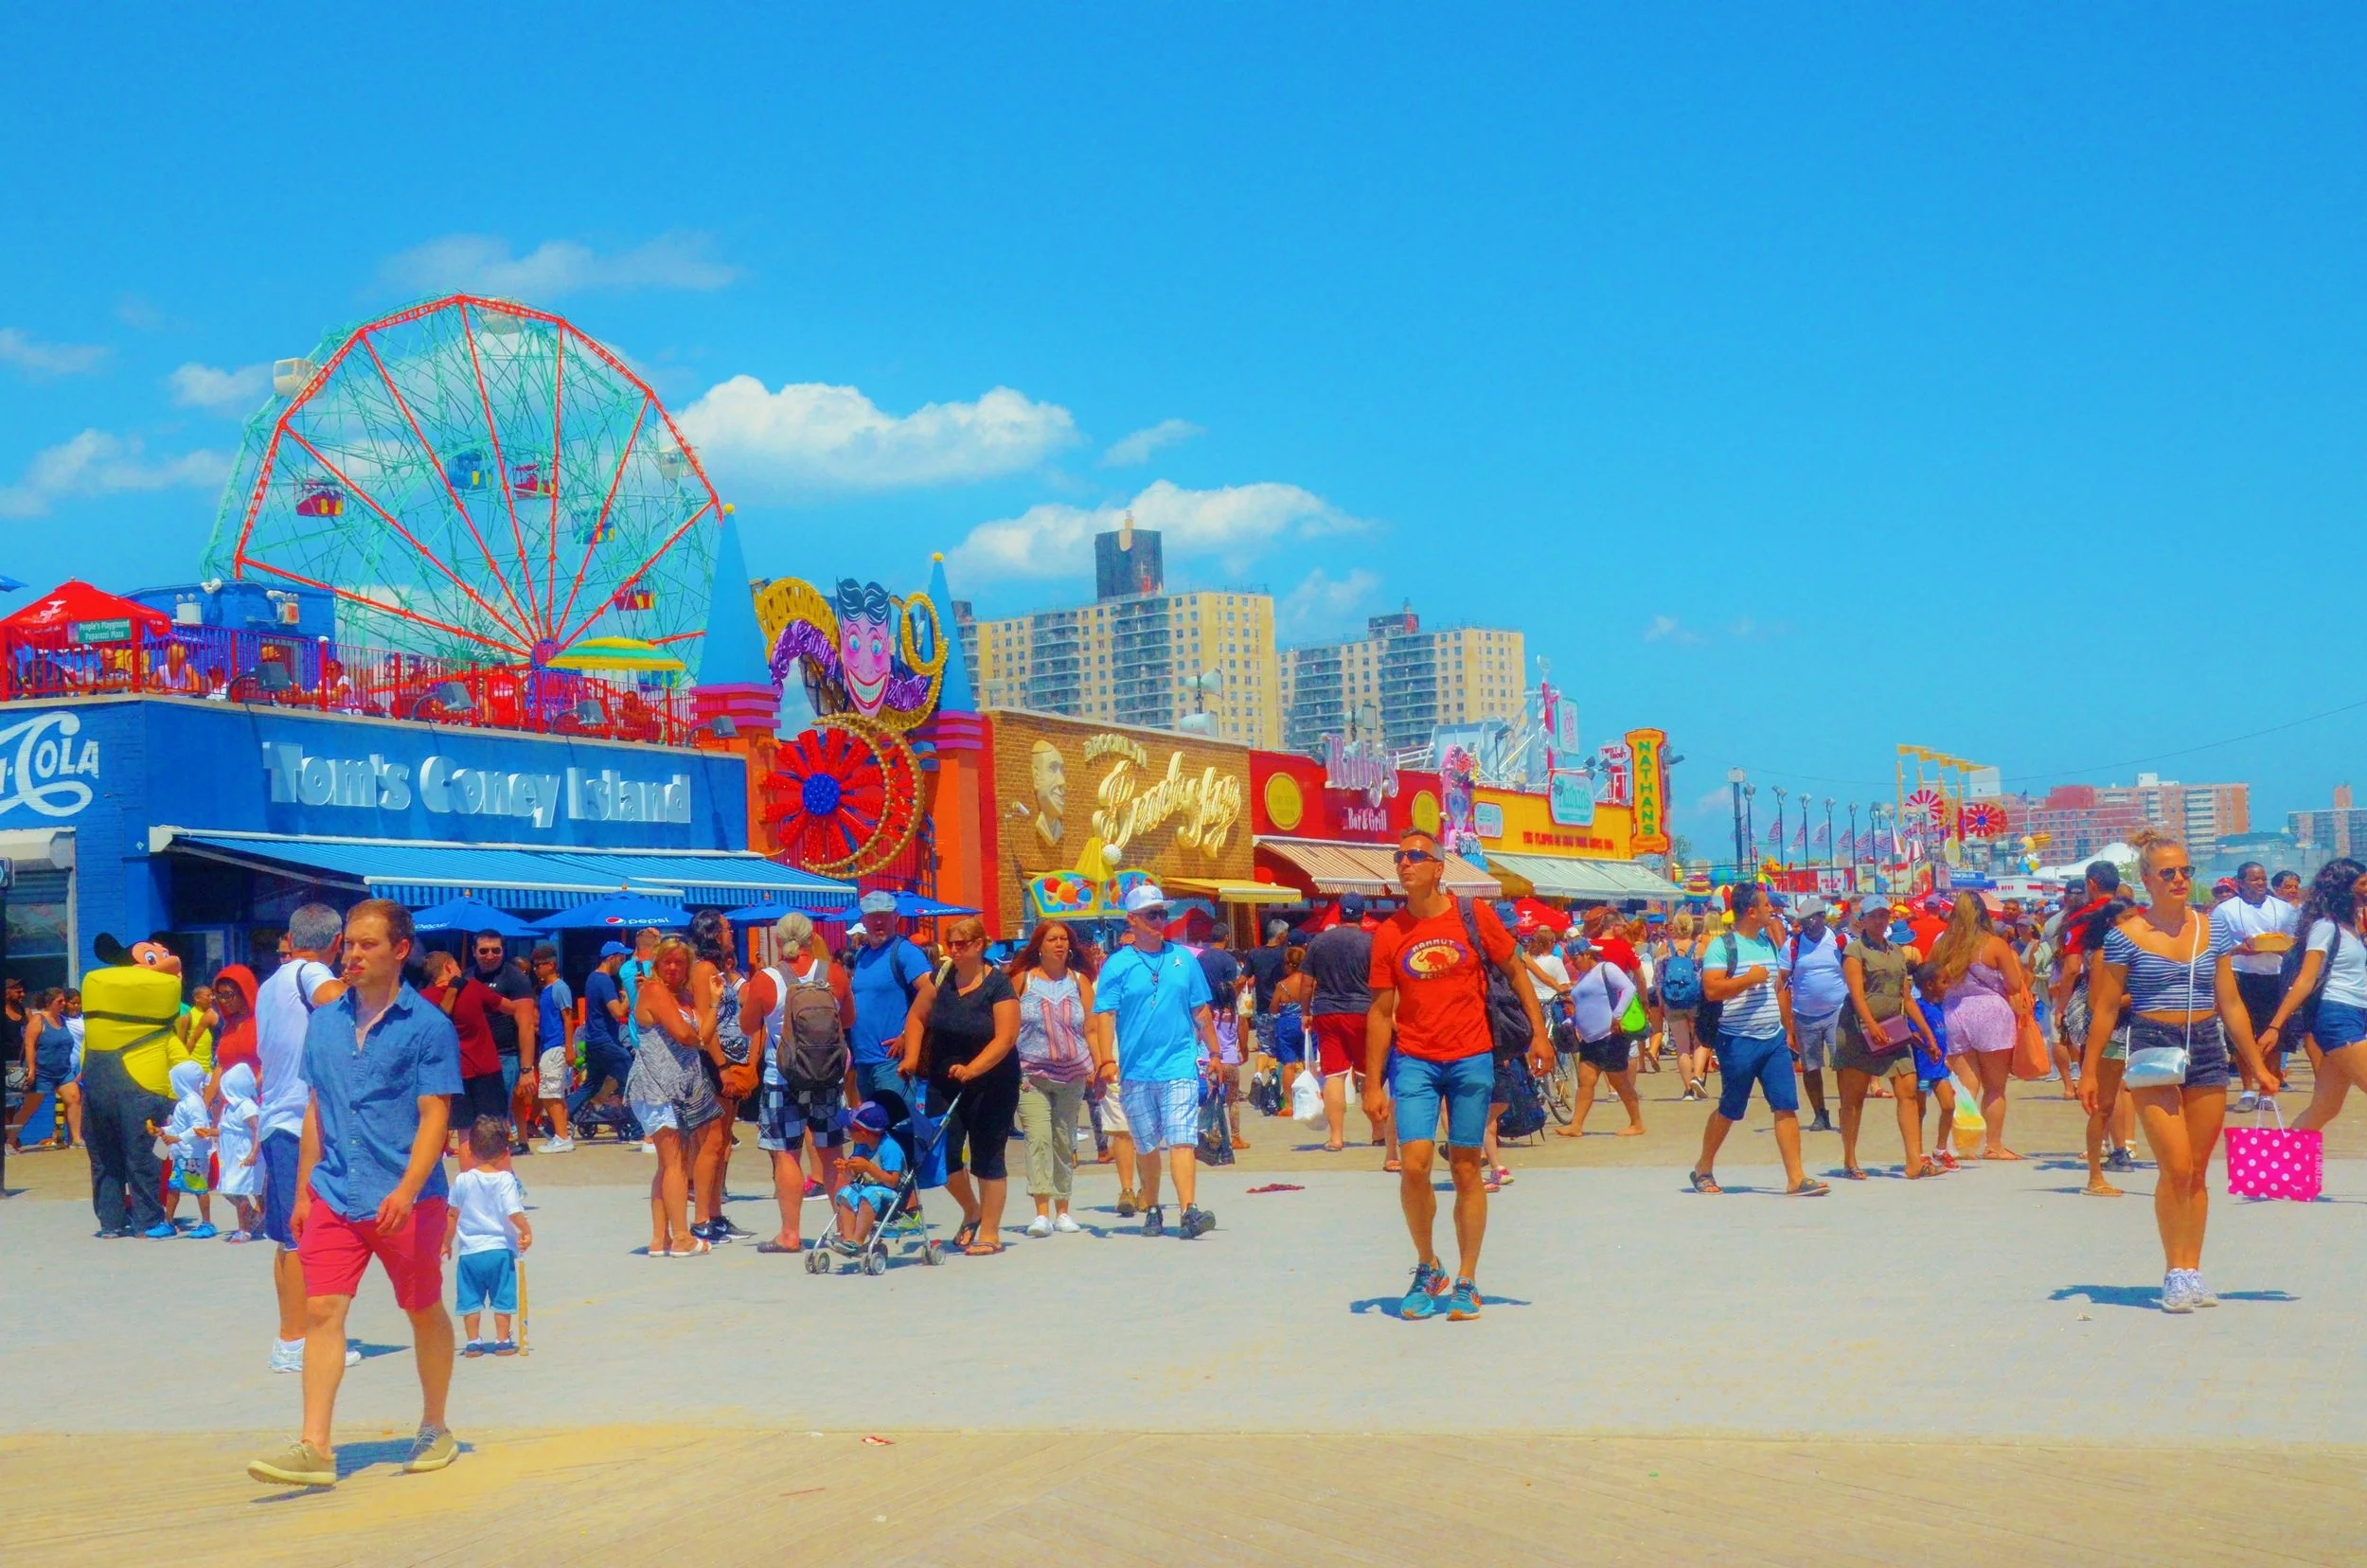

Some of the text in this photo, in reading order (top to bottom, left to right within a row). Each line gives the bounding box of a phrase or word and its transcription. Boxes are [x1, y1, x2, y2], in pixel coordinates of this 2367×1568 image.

[79, 619, 129, 632] People's Playground
[1322, 733, 1398, 808] Ruby's
[262, 741, 691, 828] Tom's Coney Island
[1638, 741, 1655, 835] NATHANS
[1347, 807, 1387, 831] Bar & Grill
[628, 917, 669, 925] pepsi
[1413, 938, 1455, 953] MAMMUT
